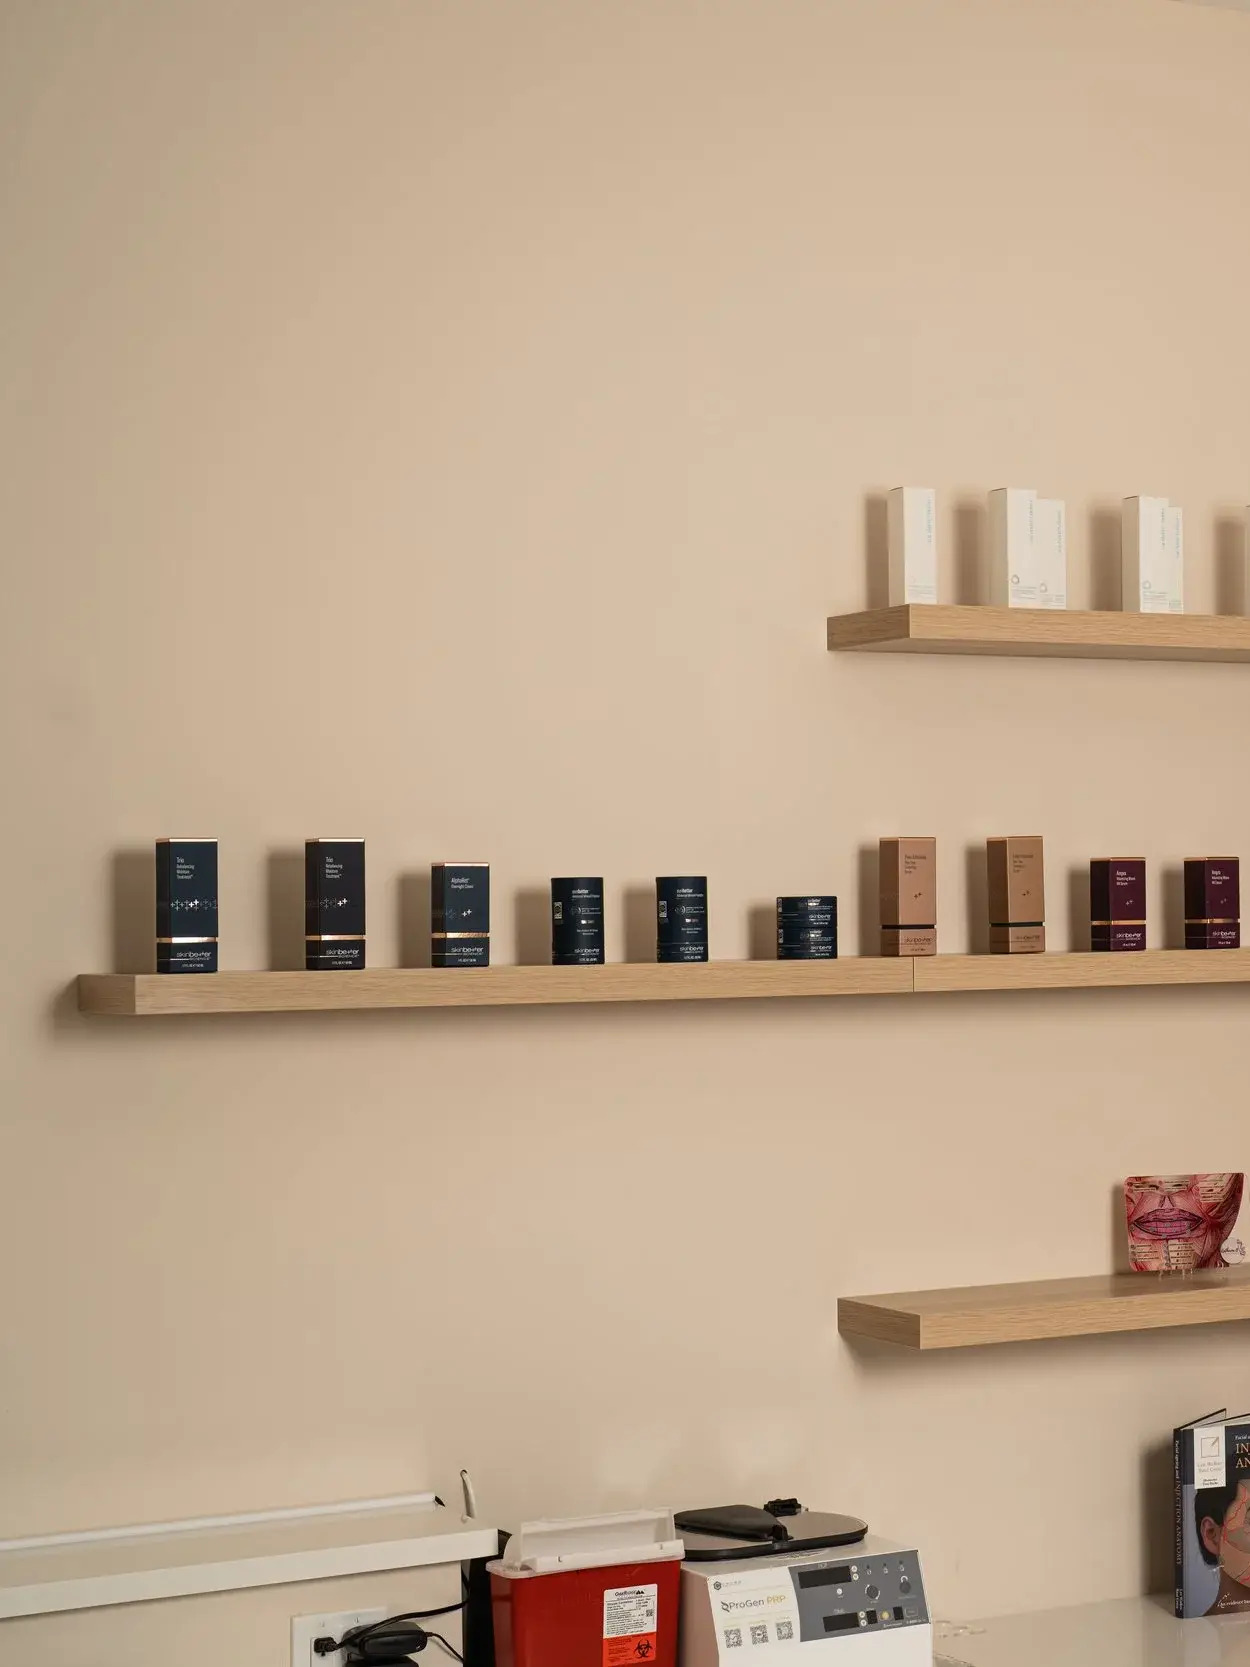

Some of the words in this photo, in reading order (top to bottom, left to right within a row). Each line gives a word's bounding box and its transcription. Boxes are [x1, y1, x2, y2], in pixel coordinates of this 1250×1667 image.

[1175, 1480, 1183, 1524] INJECTION
[1175, 1525, 1183, 1567] ANATOMY
[729, 1599, 765, 1610] ProGen
[766, 1594, 787, 1605] PRP
